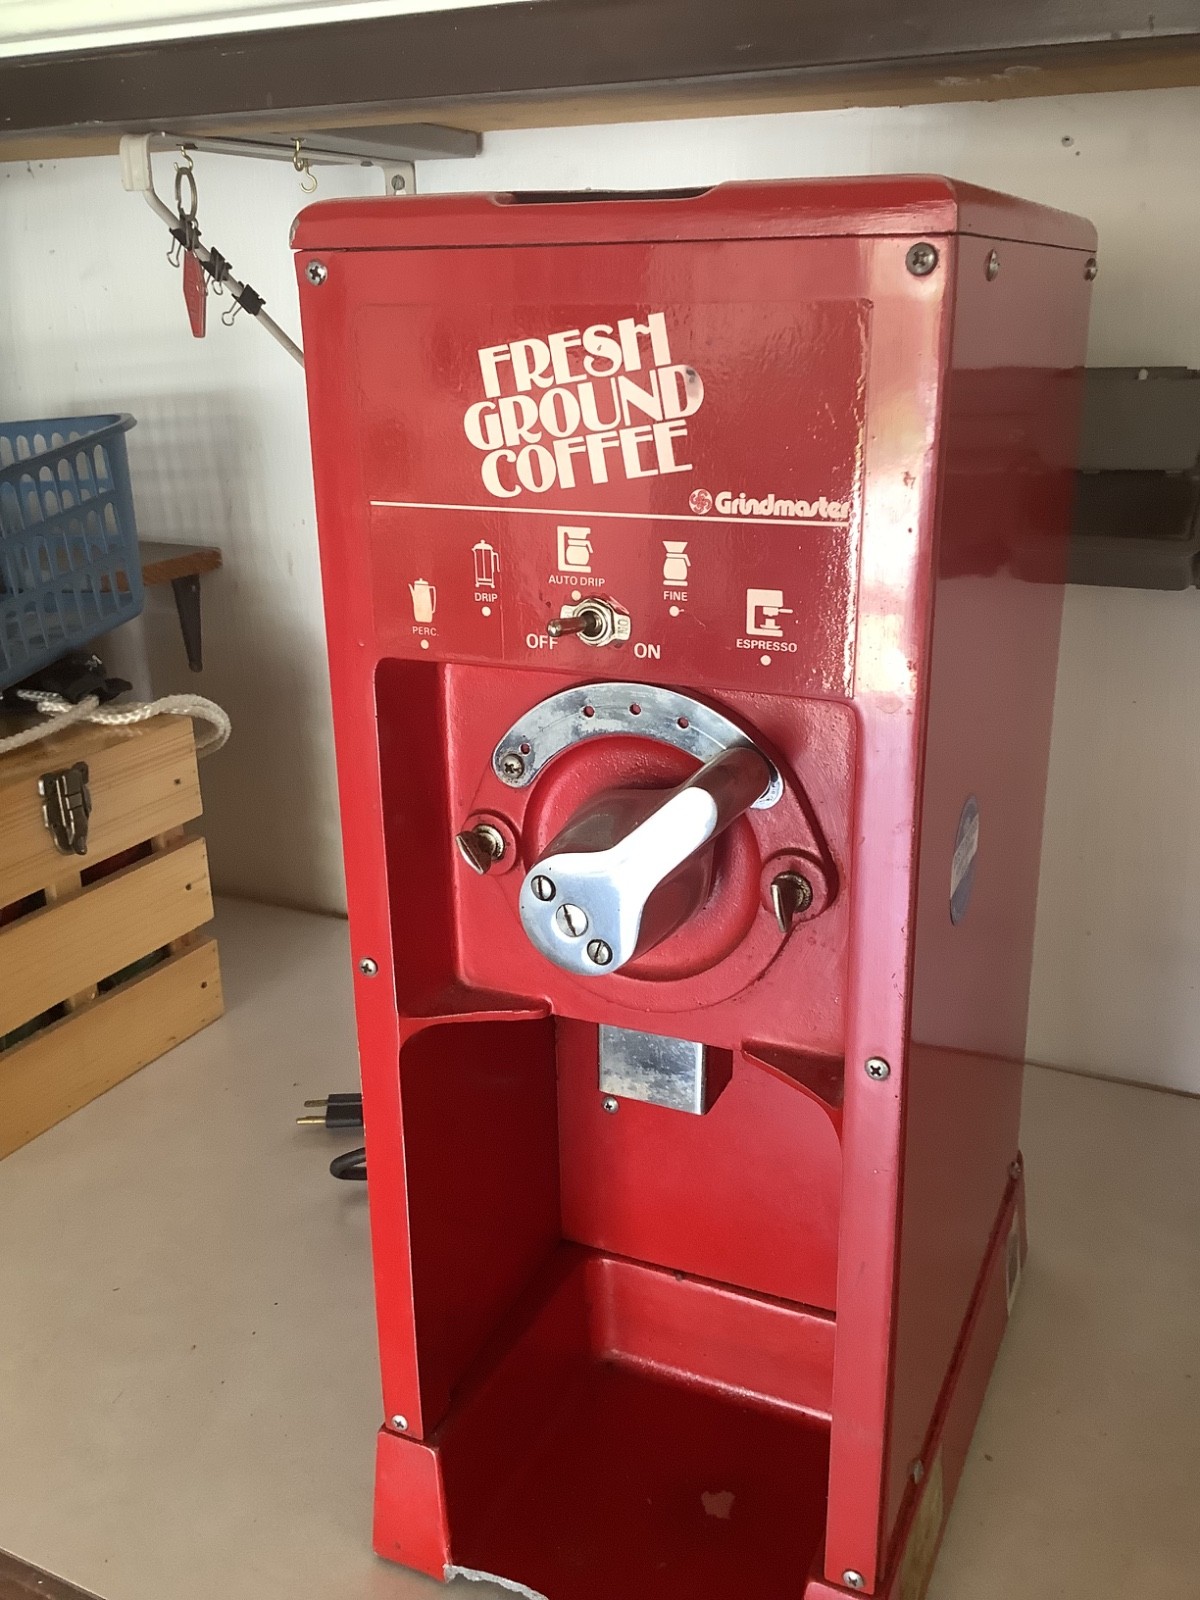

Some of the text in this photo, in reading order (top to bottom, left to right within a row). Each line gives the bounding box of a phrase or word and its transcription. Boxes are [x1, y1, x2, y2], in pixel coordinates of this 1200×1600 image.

[478, 312, 671, 398] FRESH
[464, 365, 704, 450] GROUND
[481, 420, 692, 498] COFFEE
[715, 491, 850, 518] Grindmaster
[549, 574, 605, 586] AUTO DRIP
[475, 593, 498, 602] DRIP
[663, 591, 687, 601] FINE
[413, 626, 439, 636] PERC.
[526, 633, 558, 649] OFF
[736, 639, 797, 652] ESPRESSO
[634, 643, 660, 659] ON
